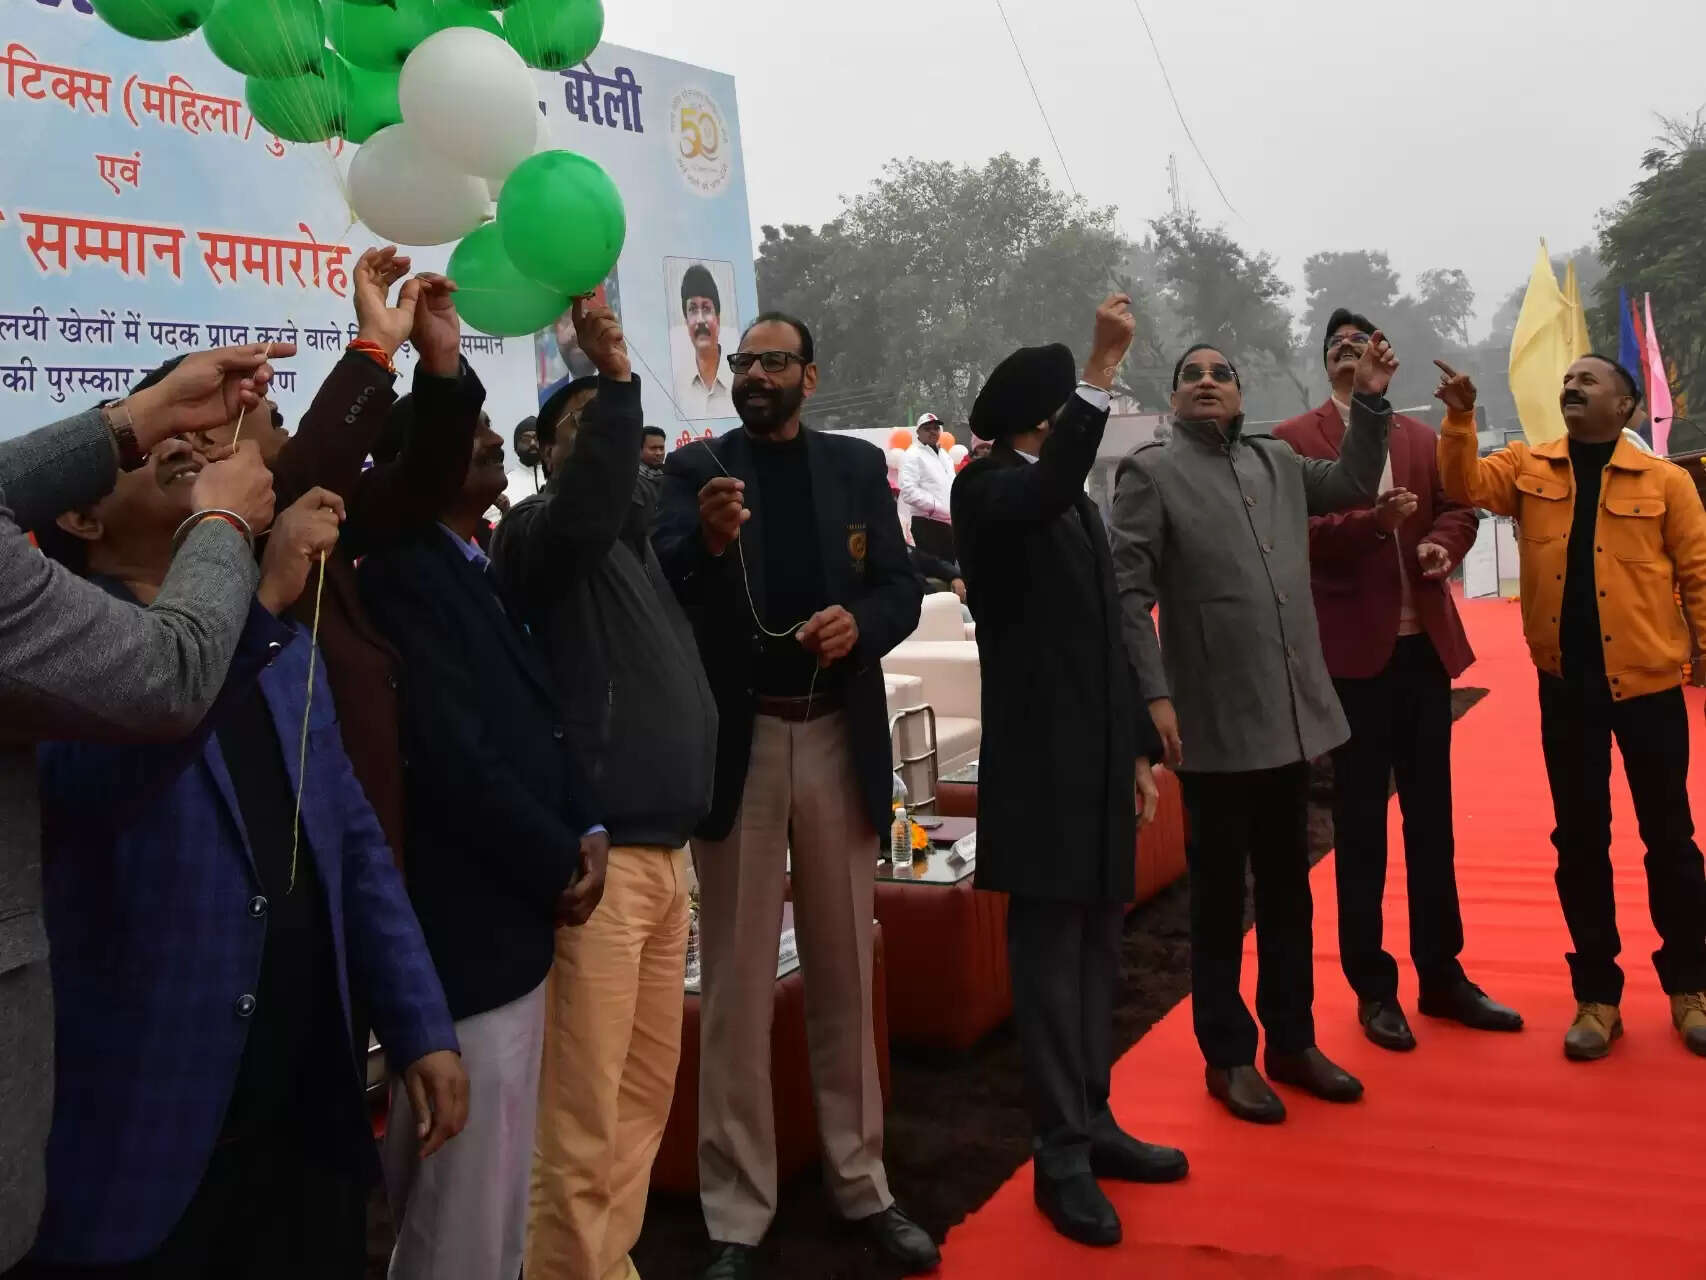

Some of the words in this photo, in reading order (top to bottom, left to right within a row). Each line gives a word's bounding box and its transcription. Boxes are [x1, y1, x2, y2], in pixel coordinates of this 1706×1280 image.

[560, 60, 644, 134] बरेली
[96, 151, 141, 195] एवं
[19, 212, 186, 280] सम्मान
[197, 222, 352, 298] समारोह
[56, 307, 116, 344] खेलों
[121, 310, 143, 345] में
[148, 322, 201, 350] पदक
[206, 324, 250, 348] प्राप्त
[304, 321, 342, 351] वाले
[460, 335, 504, 356] सम्मान
[0, 356, 38, 392] की
[44, 366, 134, 403] पुरस्कार
